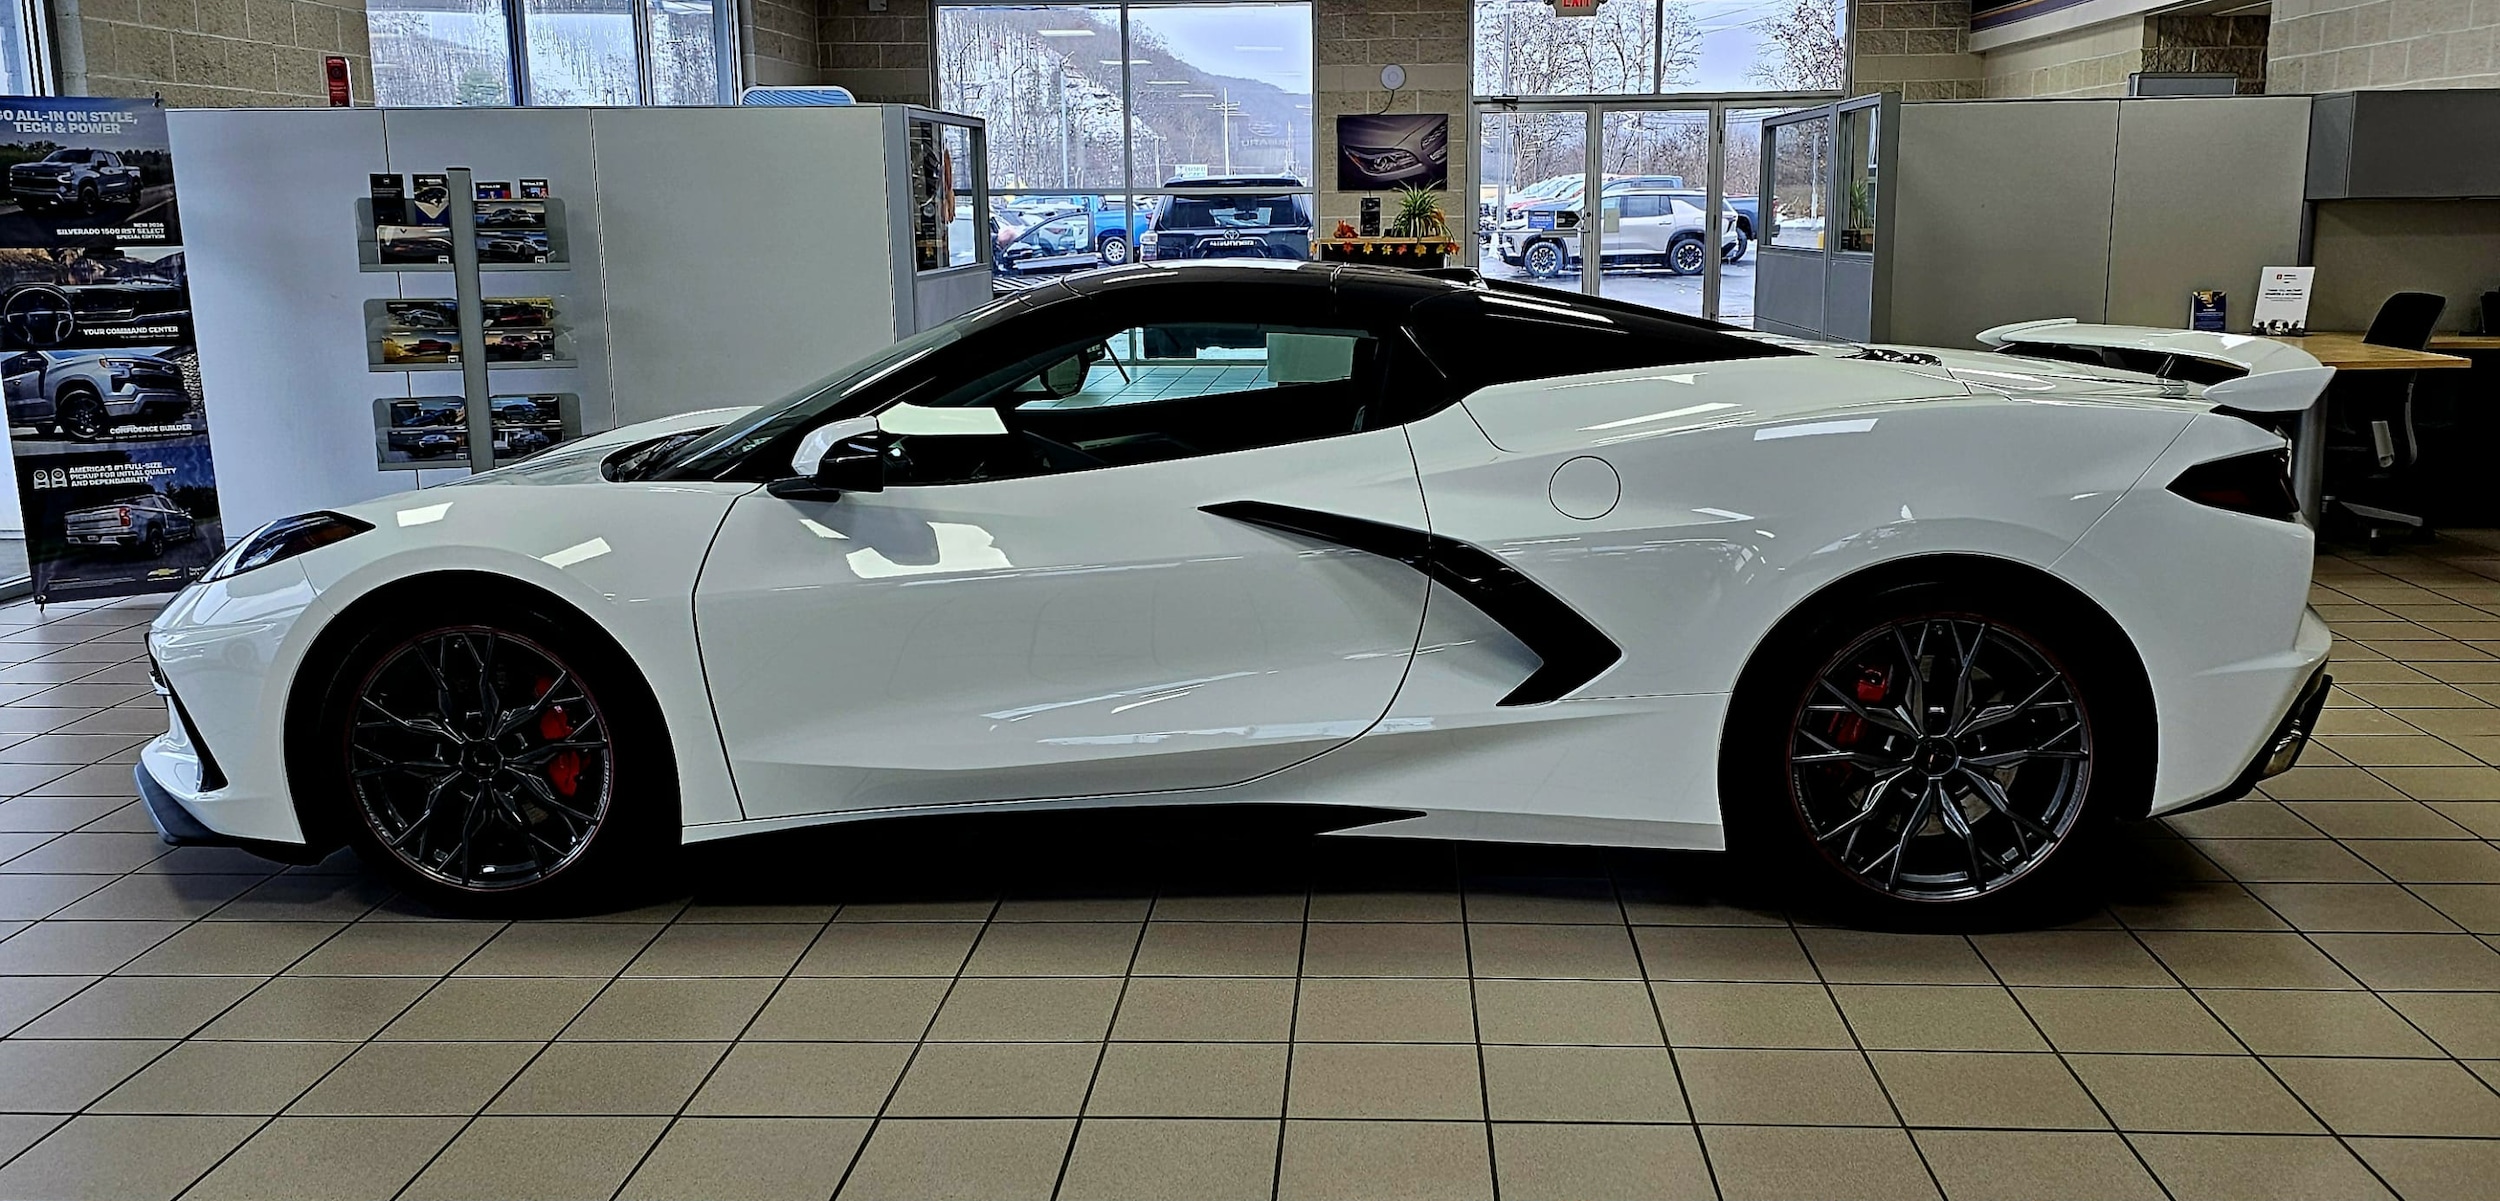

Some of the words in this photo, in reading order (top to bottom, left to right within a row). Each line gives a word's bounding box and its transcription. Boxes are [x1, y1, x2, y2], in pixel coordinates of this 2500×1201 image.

[16, 110, 65, 122] ALL-IN
[66, 111, 88, 122] ON
[90, 112, 138, 125] STYLE,
[13, 121, 53, 133] TECH
[54, 122, 66, 133] &
[68, 122, 121, 134] POWER
[106, 326, 148, 335] COMMAND
[148, 325, 179, 333] CENTER
[109, 425, 159, 434] CONFIDENCE
[159, 423, 193, 432] BUILDER
[69, 465, 113, 474] AMERICA'S
[124, 462, 163, 471] FULL-SIZE
[70, 472, 99, 480] PICKUP
[116, 469, 144, 477] INITIAL
[145, 467, 177, 476] QUALITY
